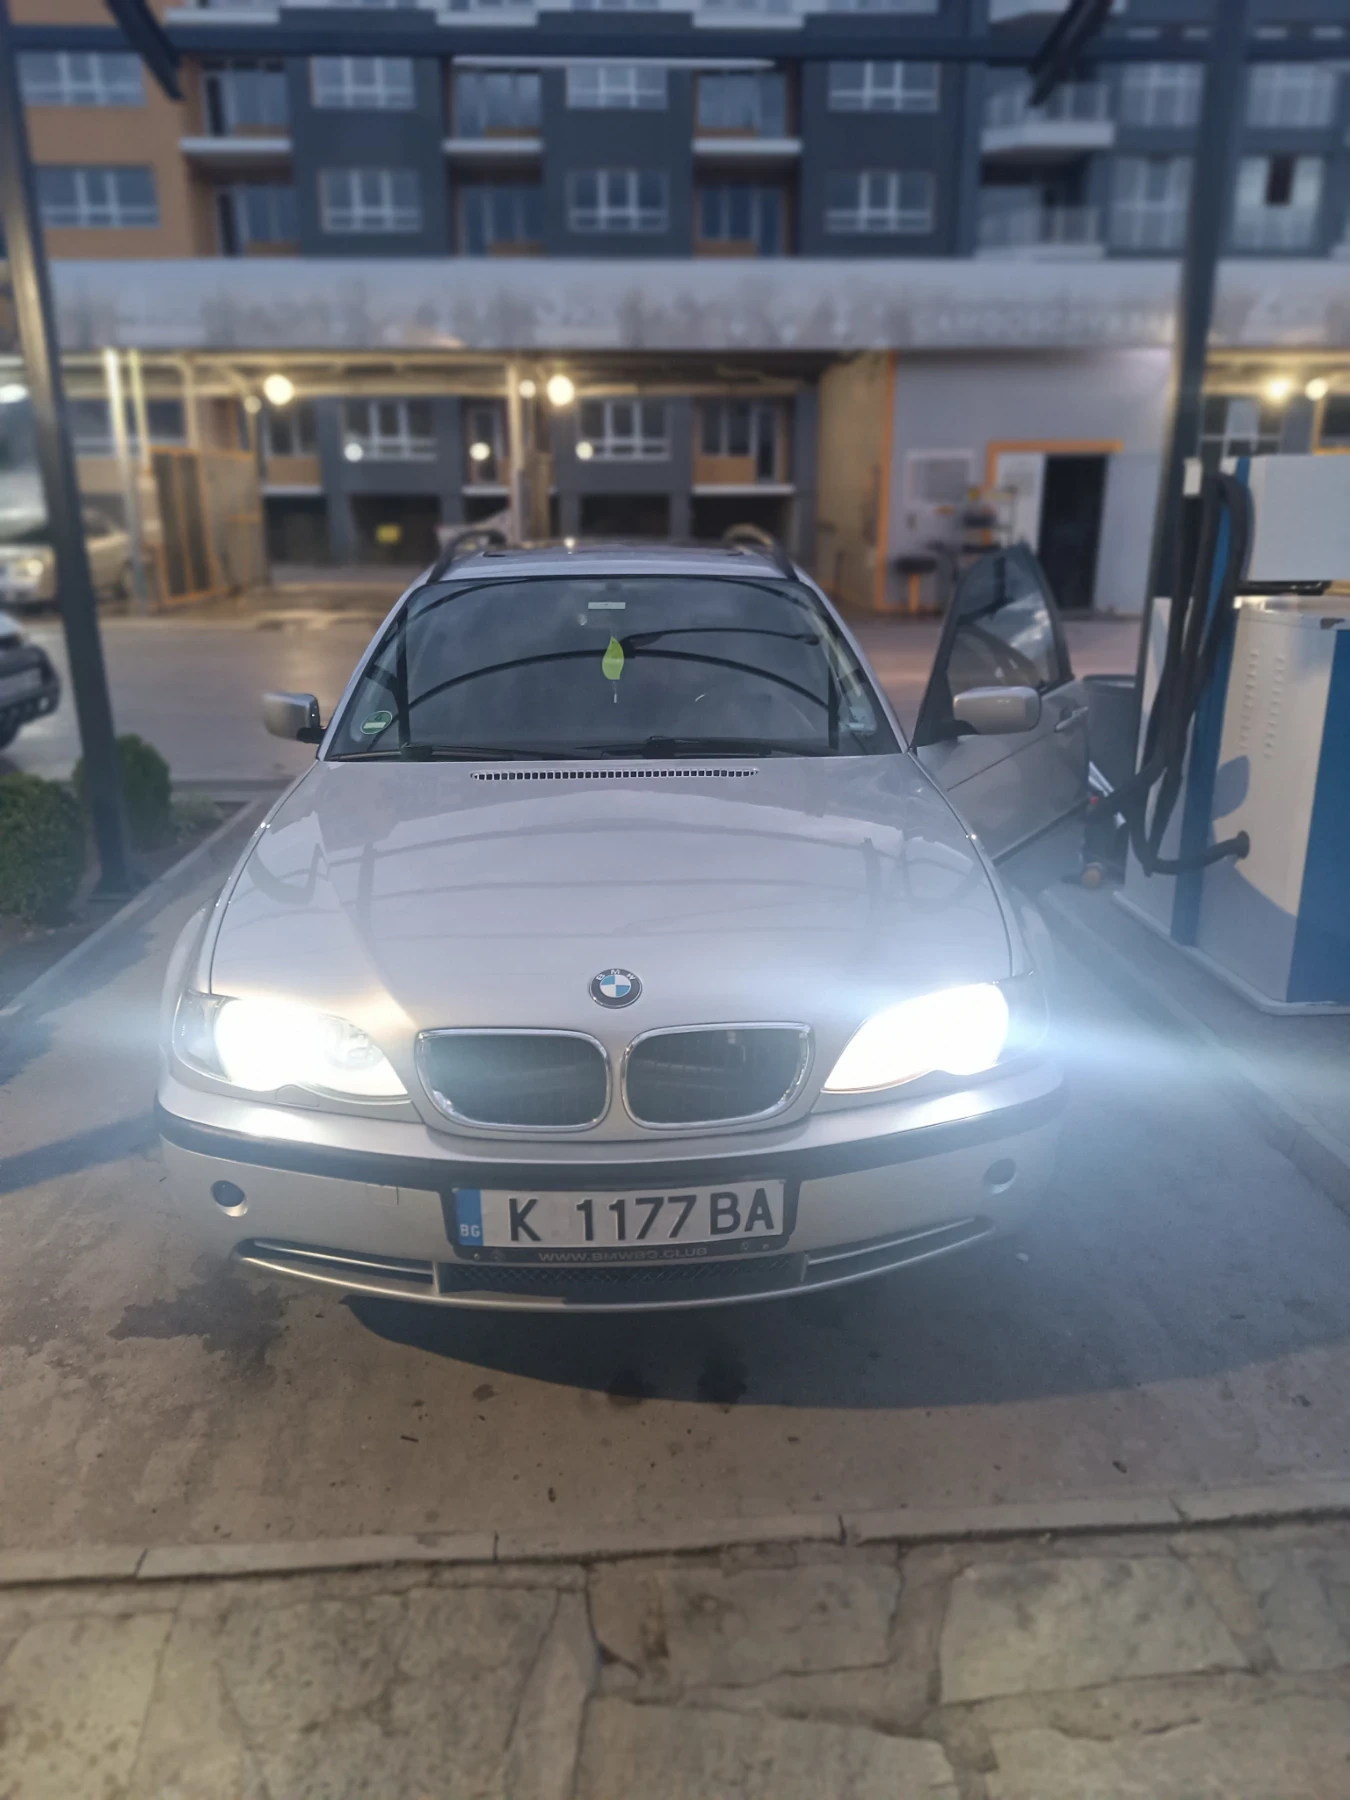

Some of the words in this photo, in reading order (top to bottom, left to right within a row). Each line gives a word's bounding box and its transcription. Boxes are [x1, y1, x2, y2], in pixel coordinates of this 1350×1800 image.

[595, 969, 636, 981] BMW
[509, 1198, 542, 1241] K
[460, 1224, 480, 1237] BG
